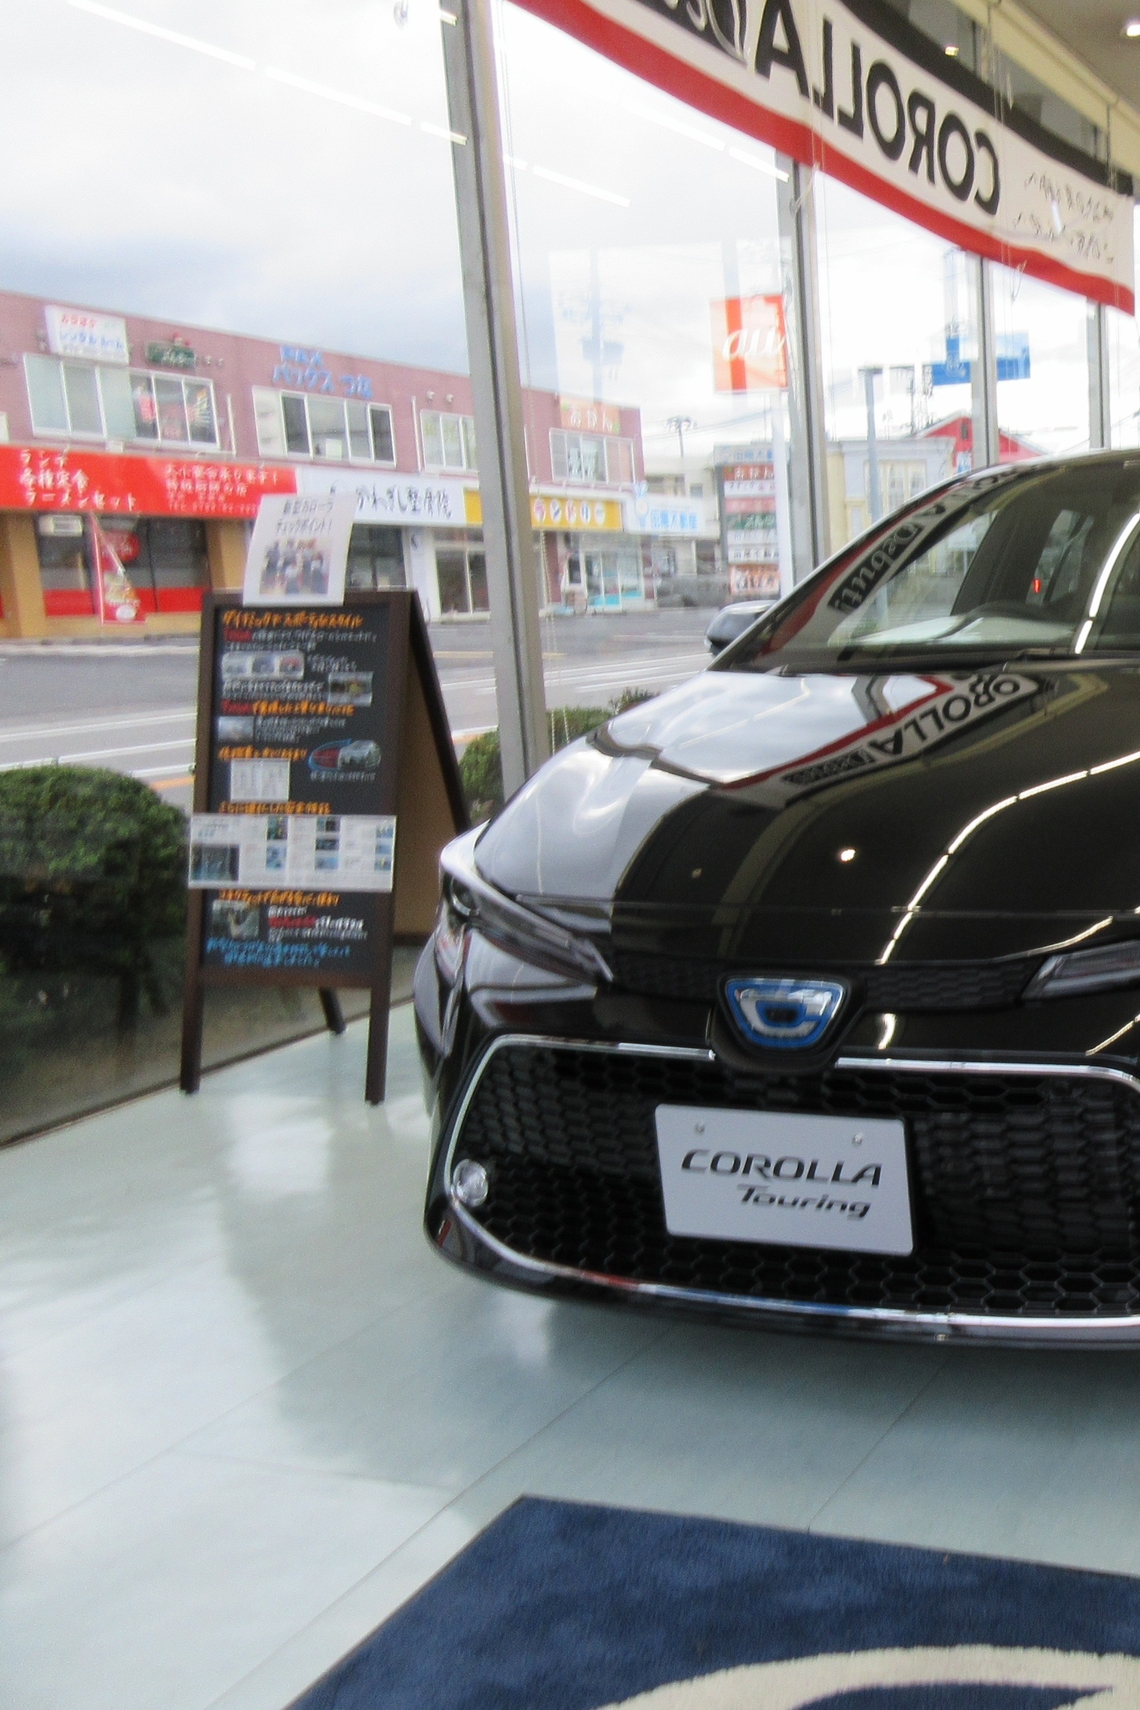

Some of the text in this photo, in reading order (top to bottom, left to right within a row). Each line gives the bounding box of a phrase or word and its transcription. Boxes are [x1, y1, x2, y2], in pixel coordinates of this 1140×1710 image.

[722, 328, 786, 361] au
[24, 489, 137, 512] ラーメンセット
[680, 1147, 883, 1188] COROLLA
[736, 1182, 872, 1222] Touring
